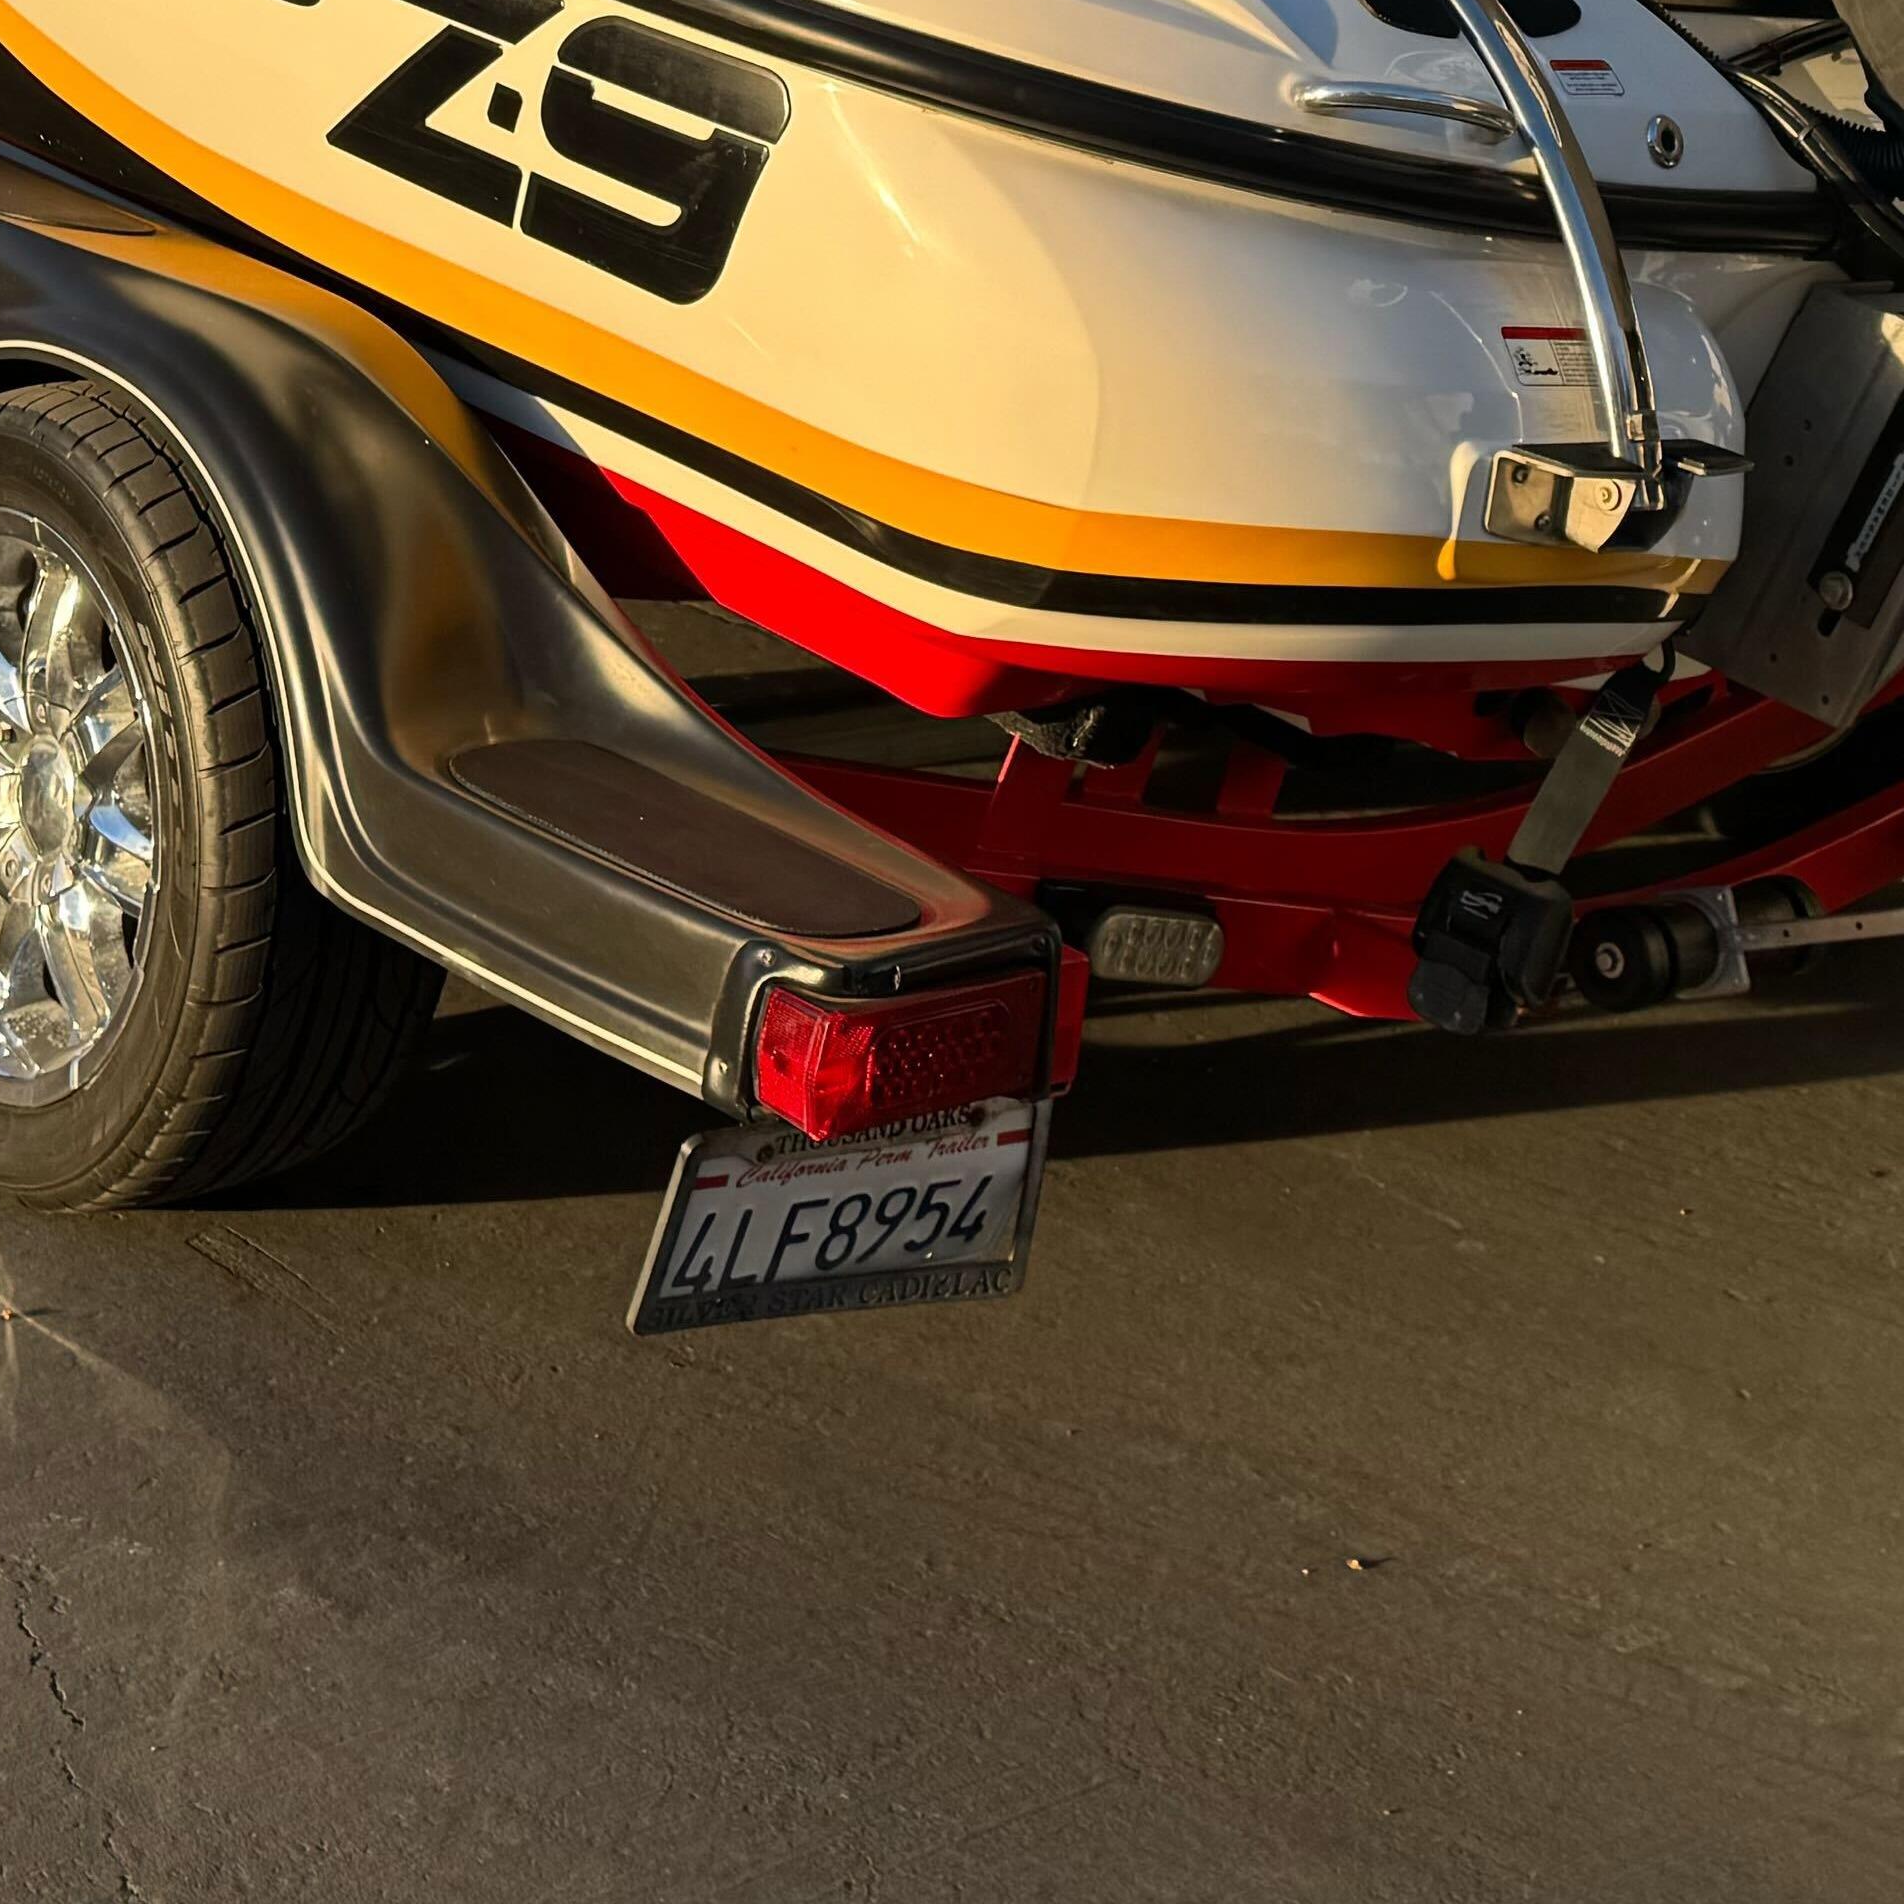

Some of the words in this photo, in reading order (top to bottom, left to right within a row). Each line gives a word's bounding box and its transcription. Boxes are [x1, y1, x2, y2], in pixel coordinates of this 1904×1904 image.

[913, 1106, 973, 1138] OAKS
[736, 1153, 848, 1189] California
[857, 1146, 914, 1171] Perm
[925, 1133, 990, 1159] Trailer
[670, 1175, 994, 1292] 4LF8954
[766, 1282, 847, 1317] STAR
